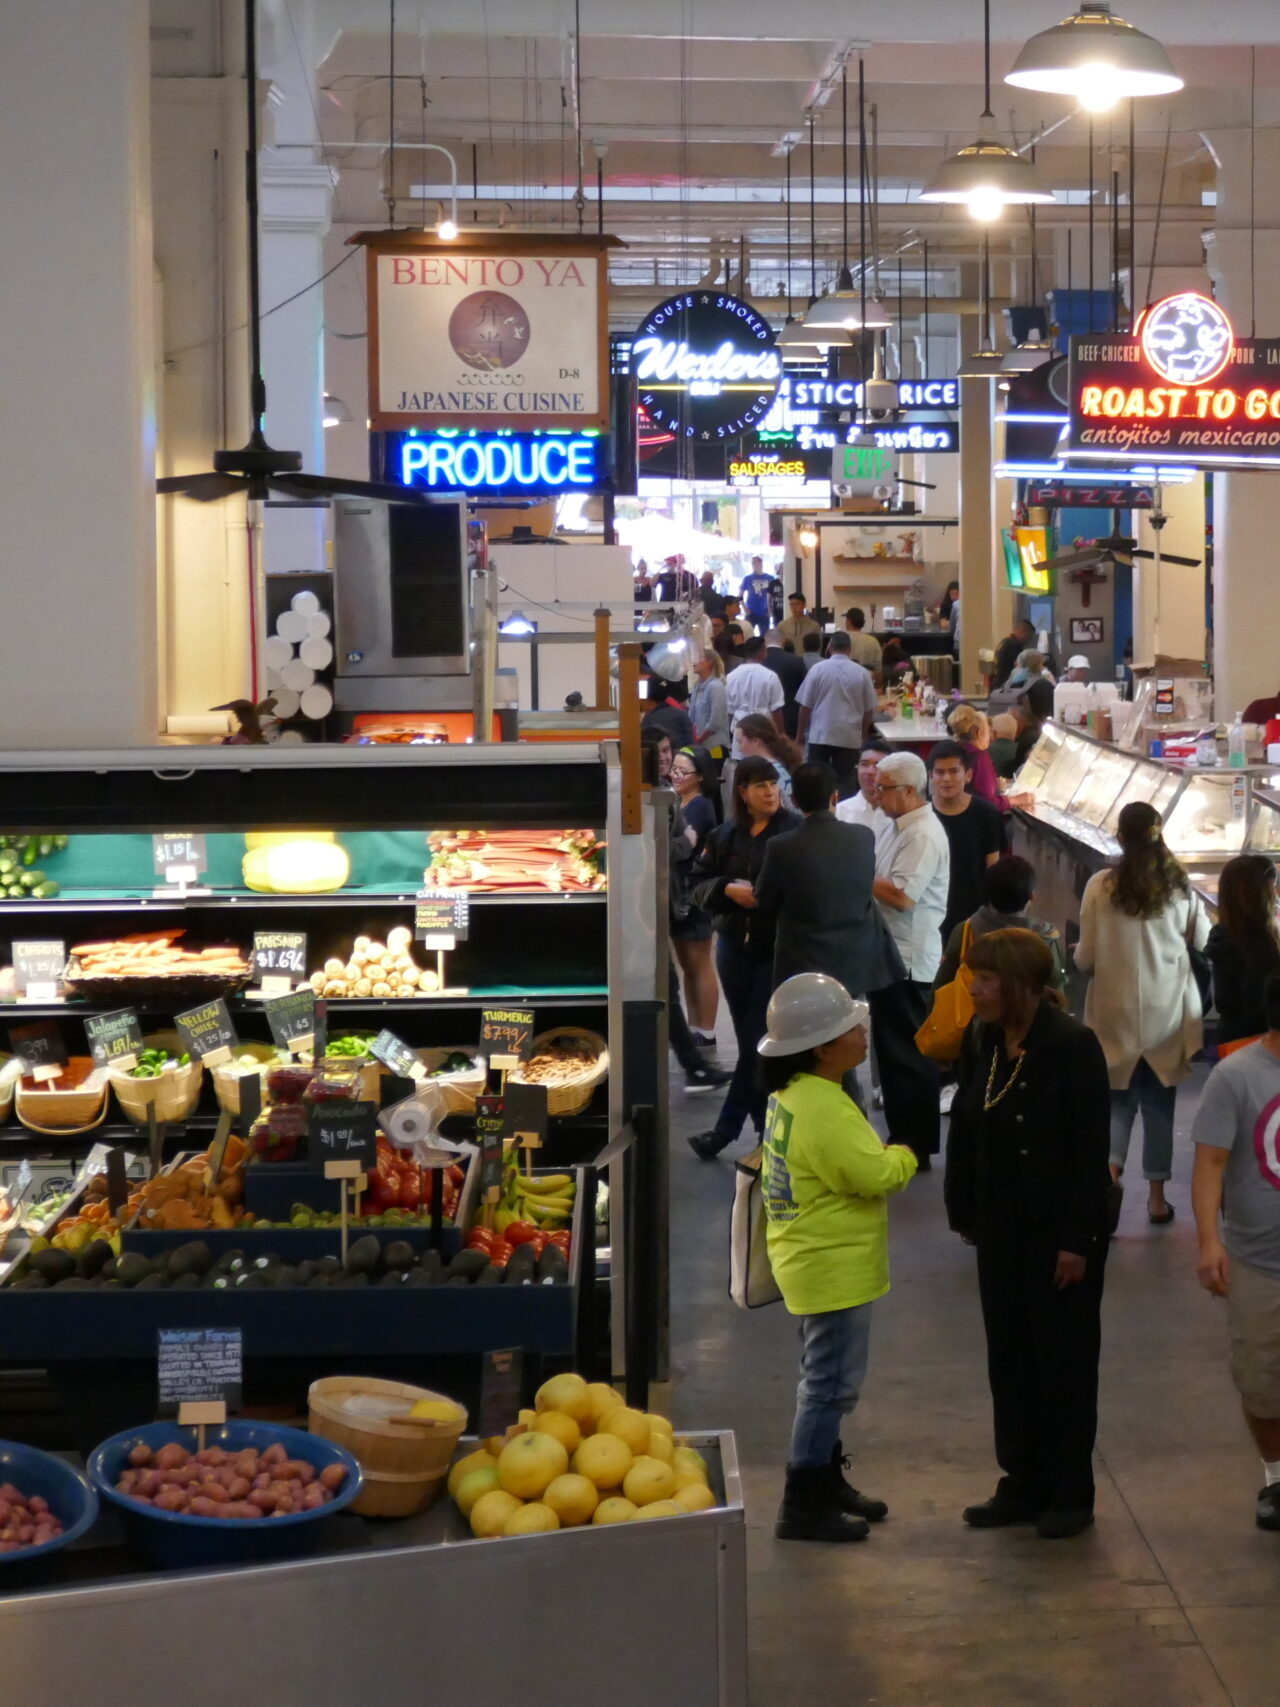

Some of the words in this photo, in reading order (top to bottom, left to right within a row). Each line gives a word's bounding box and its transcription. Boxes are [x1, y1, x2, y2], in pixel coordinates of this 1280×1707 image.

[391, 257, 525, 287] BENTO
[534, 259, 587, 287] YA
[646, 297, 694, 334] HOUSE
[716, 297, 767, 340] SMOKED
[1231, 347, 1254, 364] PORK
[559, 368, 580, 379] D-8
[397, 391, 500, 411] JAPANESE
[503, 392, 585, 412] CUISINE
[899, 383, 956, 405] RICE
[1081, 386, 1187, 418] ROAST
[1192, 388, 1237, 419] TO
[643, 395, 694, 437] HAND
[717, 396, 768, 437] SLICED
[1080, 423, 1171, 451] antojitos
[401, 440, 595, 488] PRODUCE
[730, 461, 805, 477] SAUSAGES
[843, 448, 886, 480] EXIT
[1032, 487, 1153, 505] PIZZA
[255, 935, 303, 950] PARSNIP
[177, 1003, 220, 1029] YELLOW
[482, 1011, 533, 1024] TURMERIC
[311, 1103, 367, 1119] Avocado
